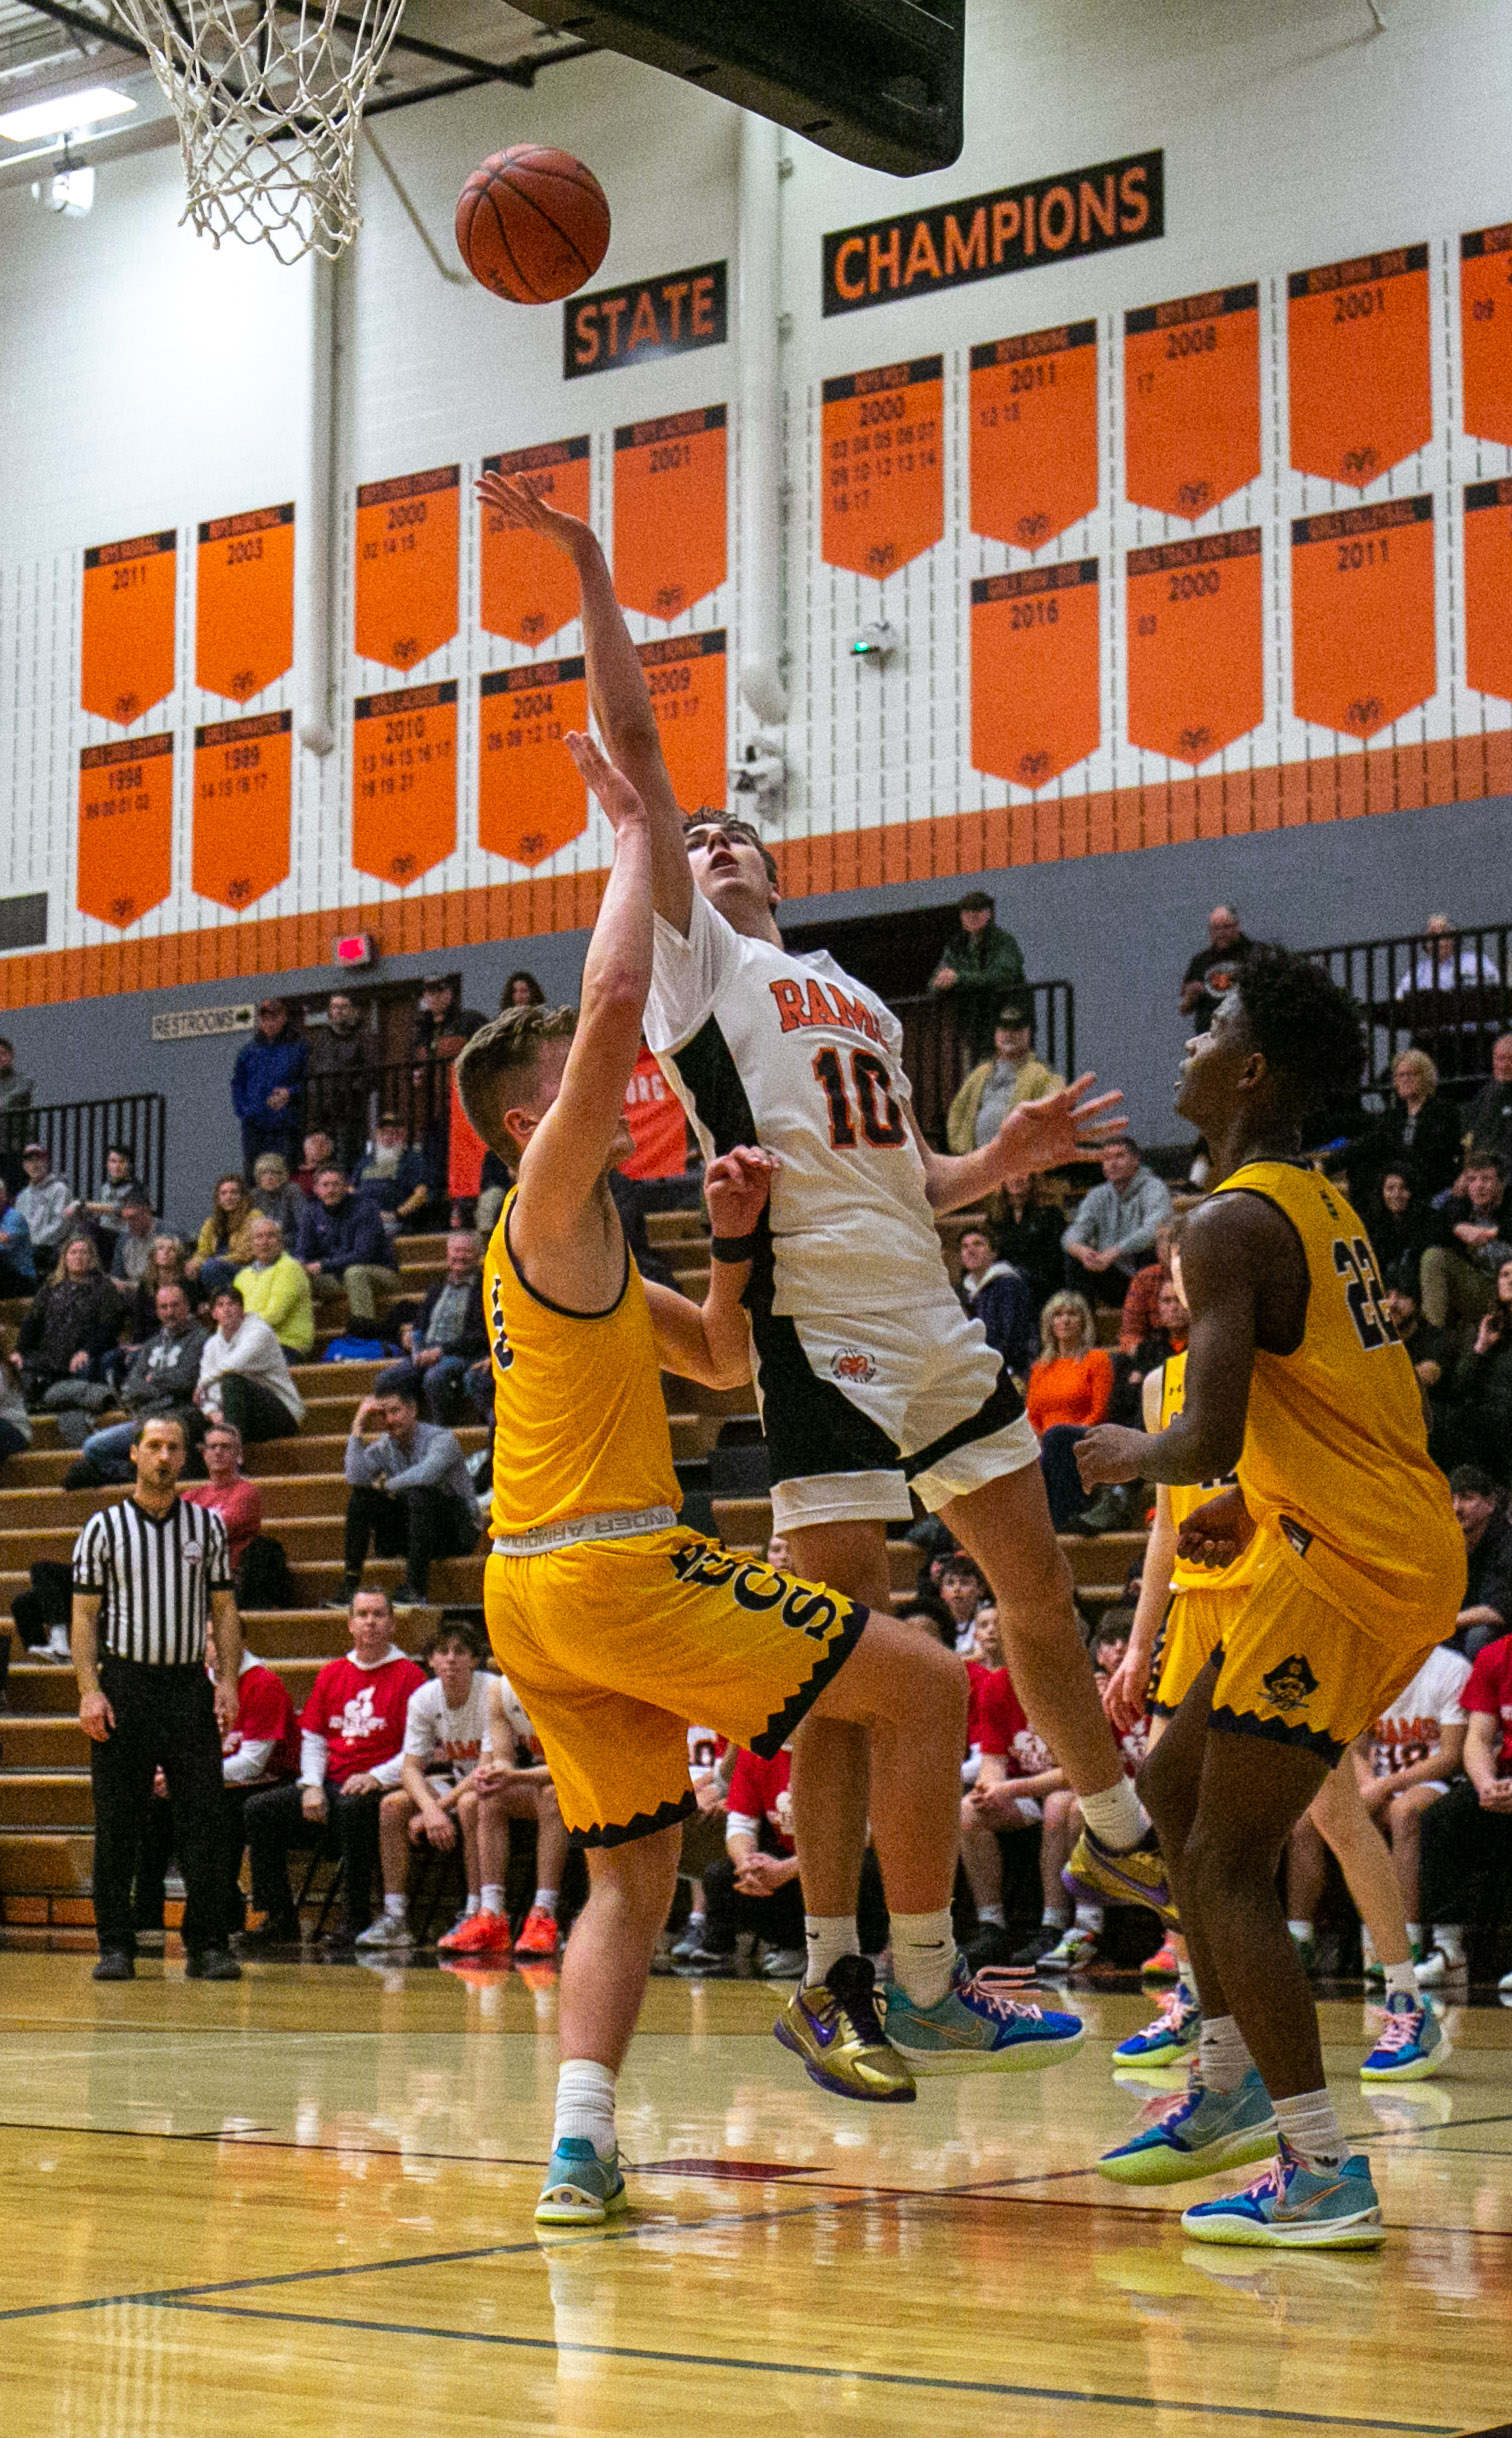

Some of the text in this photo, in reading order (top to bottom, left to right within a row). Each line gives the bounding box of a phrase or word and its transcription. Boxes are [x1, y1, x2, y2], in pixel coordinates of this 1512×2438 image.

[575, 167, 1149, 363] STATE CHAMPIONS
[1333, 288, 1385, 324] 2001
[1010, 361, 1056, 394] 2011
[859, 395, 905, 427] 2000
[1337, 539, 1389, 571] 2011
[112, 565, 146, 591] 2011
[1168, 570, 1219, 602] 2000
[1010, 599, 1059, 631] 2016
[648, 667, 691, 696] 2009
[512, 693, 553, 721] 2004
[386, 716, 425, 744] 2010
[154, 1009, 236, 1037] RESTROOMS
[812, 1047, 907, 1149] 10
